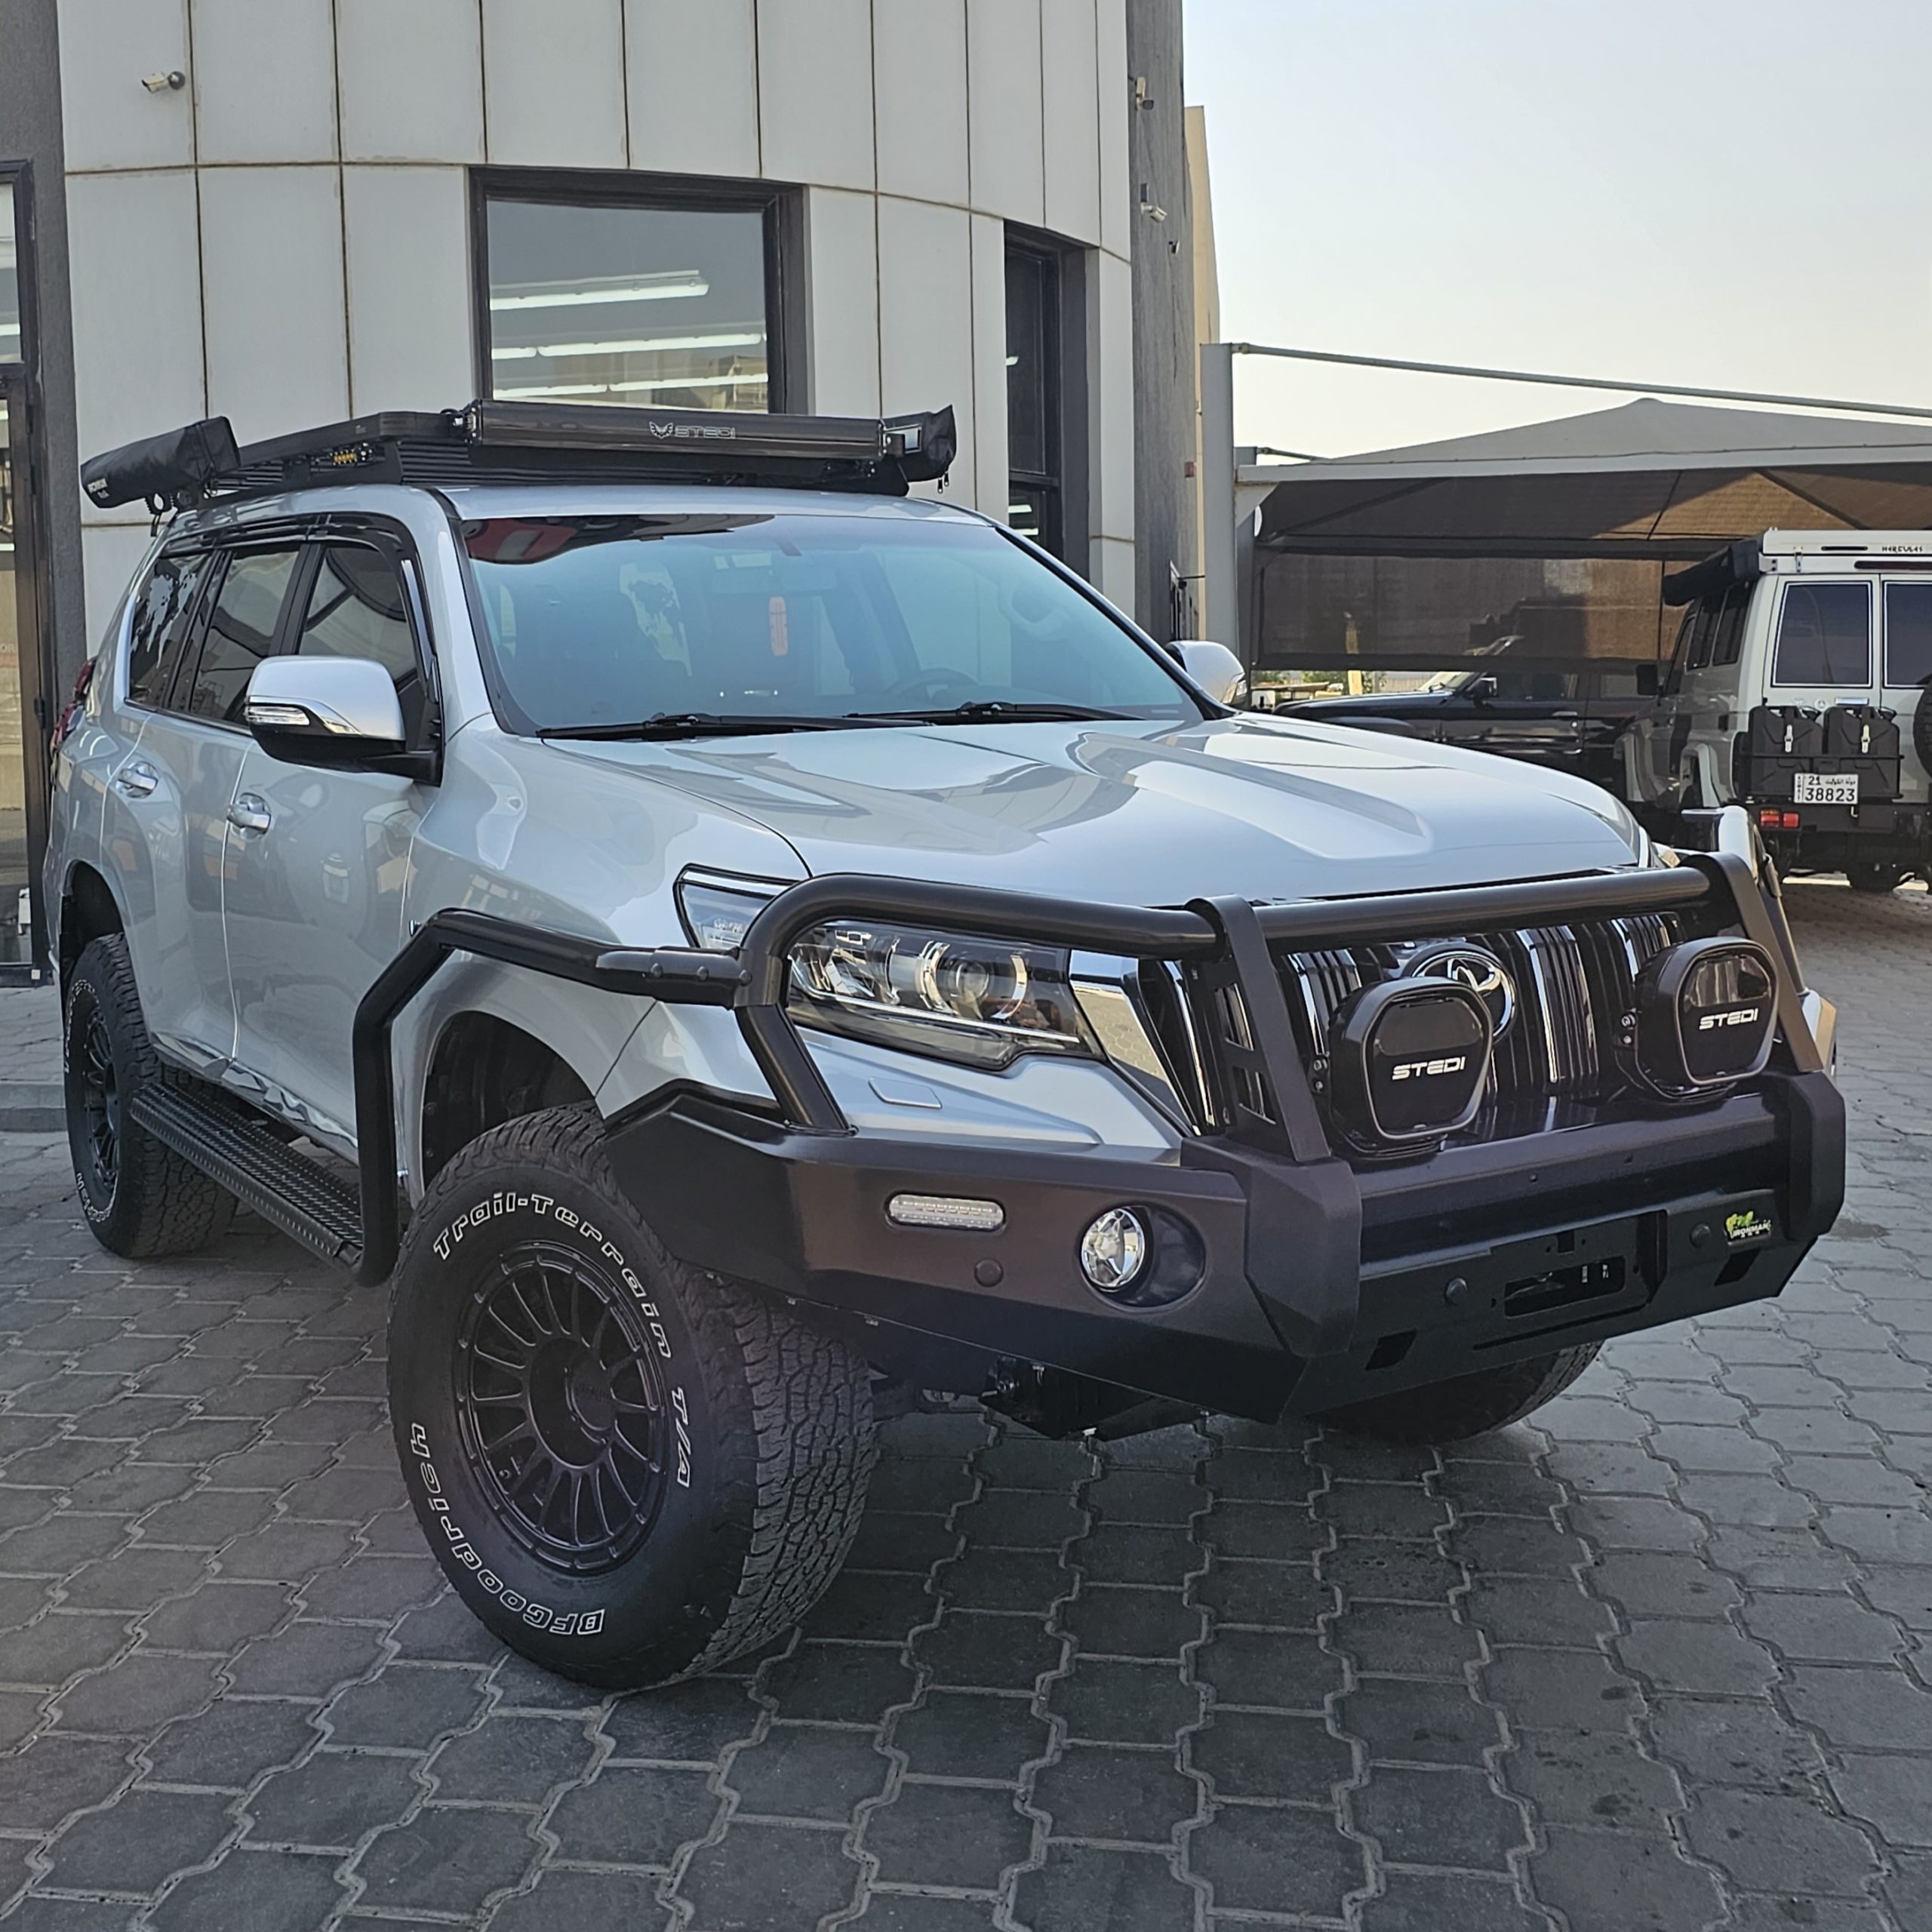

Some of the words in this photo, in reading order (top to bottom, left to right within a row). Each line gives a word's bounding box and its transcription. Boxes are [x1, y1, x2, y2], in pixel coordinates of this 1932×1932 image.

[675, 425, 737, 439] STEDI
[1808, 776, 1820, 786] 21
[1804, 787, 1855, 802] 38823
[1699, 1008, 1758, 1030] STEDI
[1392, 1056, 1466, 1081] STEDI
[432, 1192, 672, 1358] Trail-Terrain
[671, 1386, 691, 1488] T/A
[410, 1423, 605, 1635] BFGoodrich
